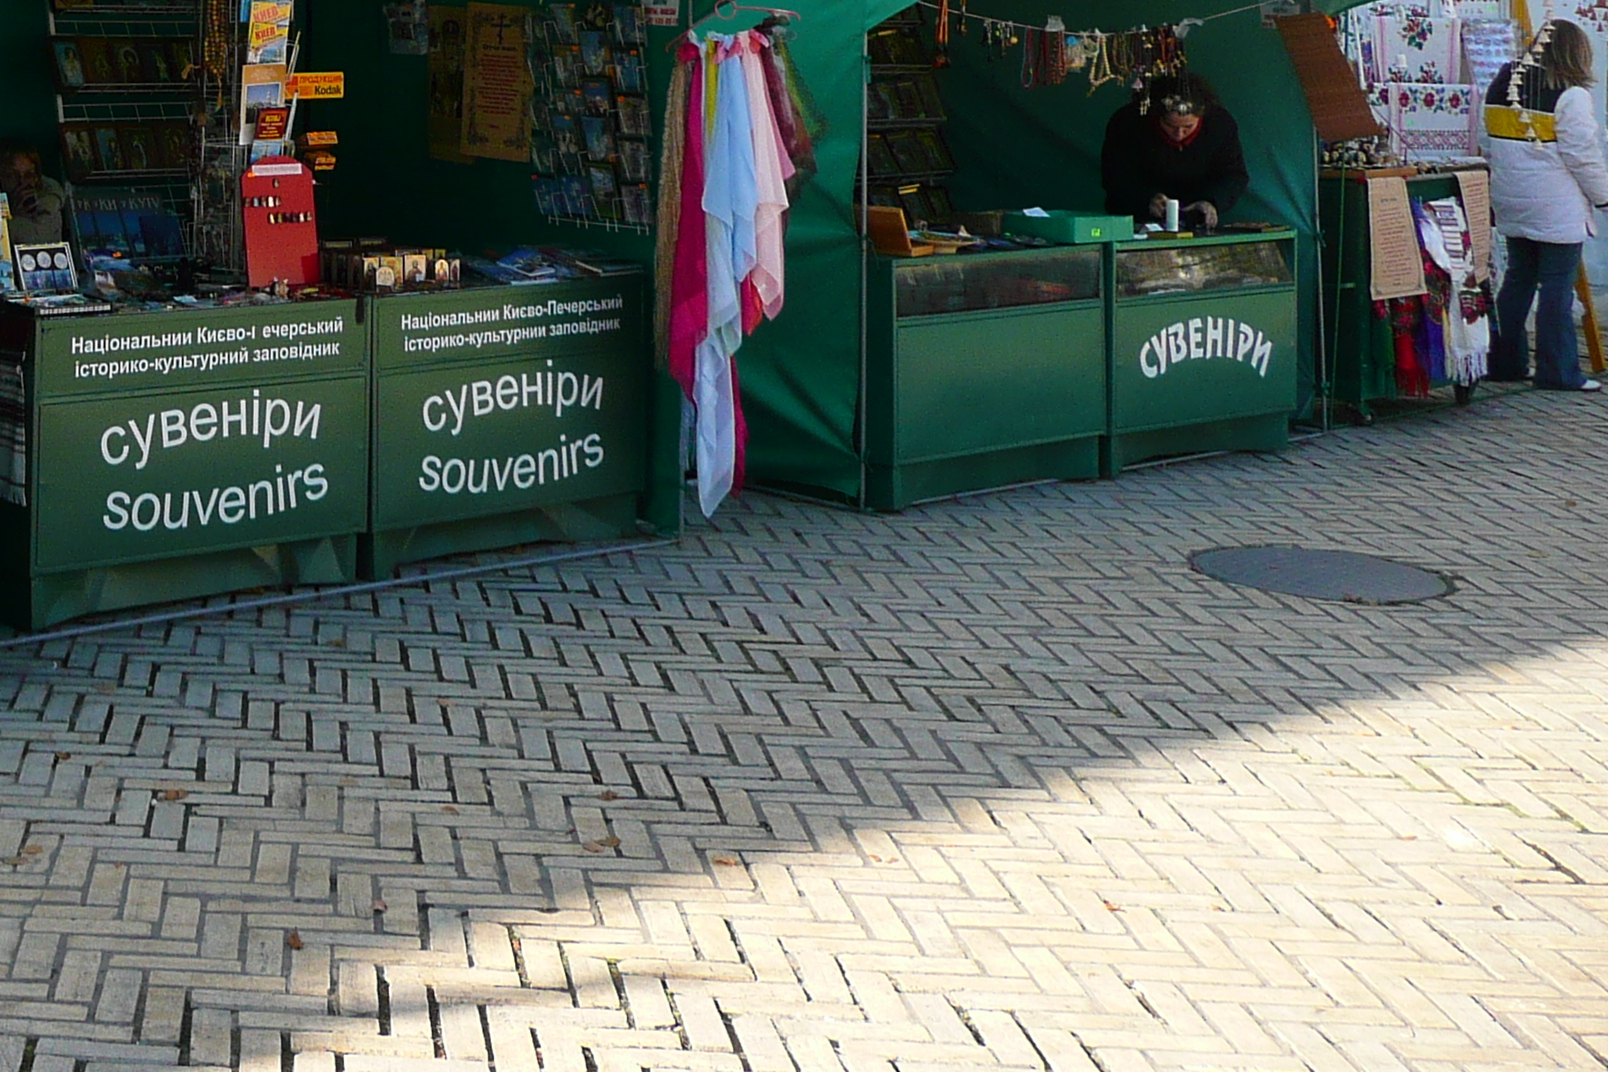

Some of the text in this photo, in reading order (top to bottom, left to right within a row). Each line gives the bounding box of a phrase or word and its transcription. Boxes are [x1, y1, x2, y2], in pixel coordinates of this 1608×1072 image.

[314, 85, 342, 95] Kodak
[503, 293, 623, 320] Києво-Печерський
[549, 317, 621, 336] заповідник
[75, 341, 340, 379] історико-культурний заповідник
[1140, 316, 1273, 378] СУВЕНІРИ
[423, 360, 604, 435] сувеніри
[100, 389, 322, 470] сувеніри
[419, 432, 605, 494] souvenirs
[103, 463, 329, 530] souvenirs
